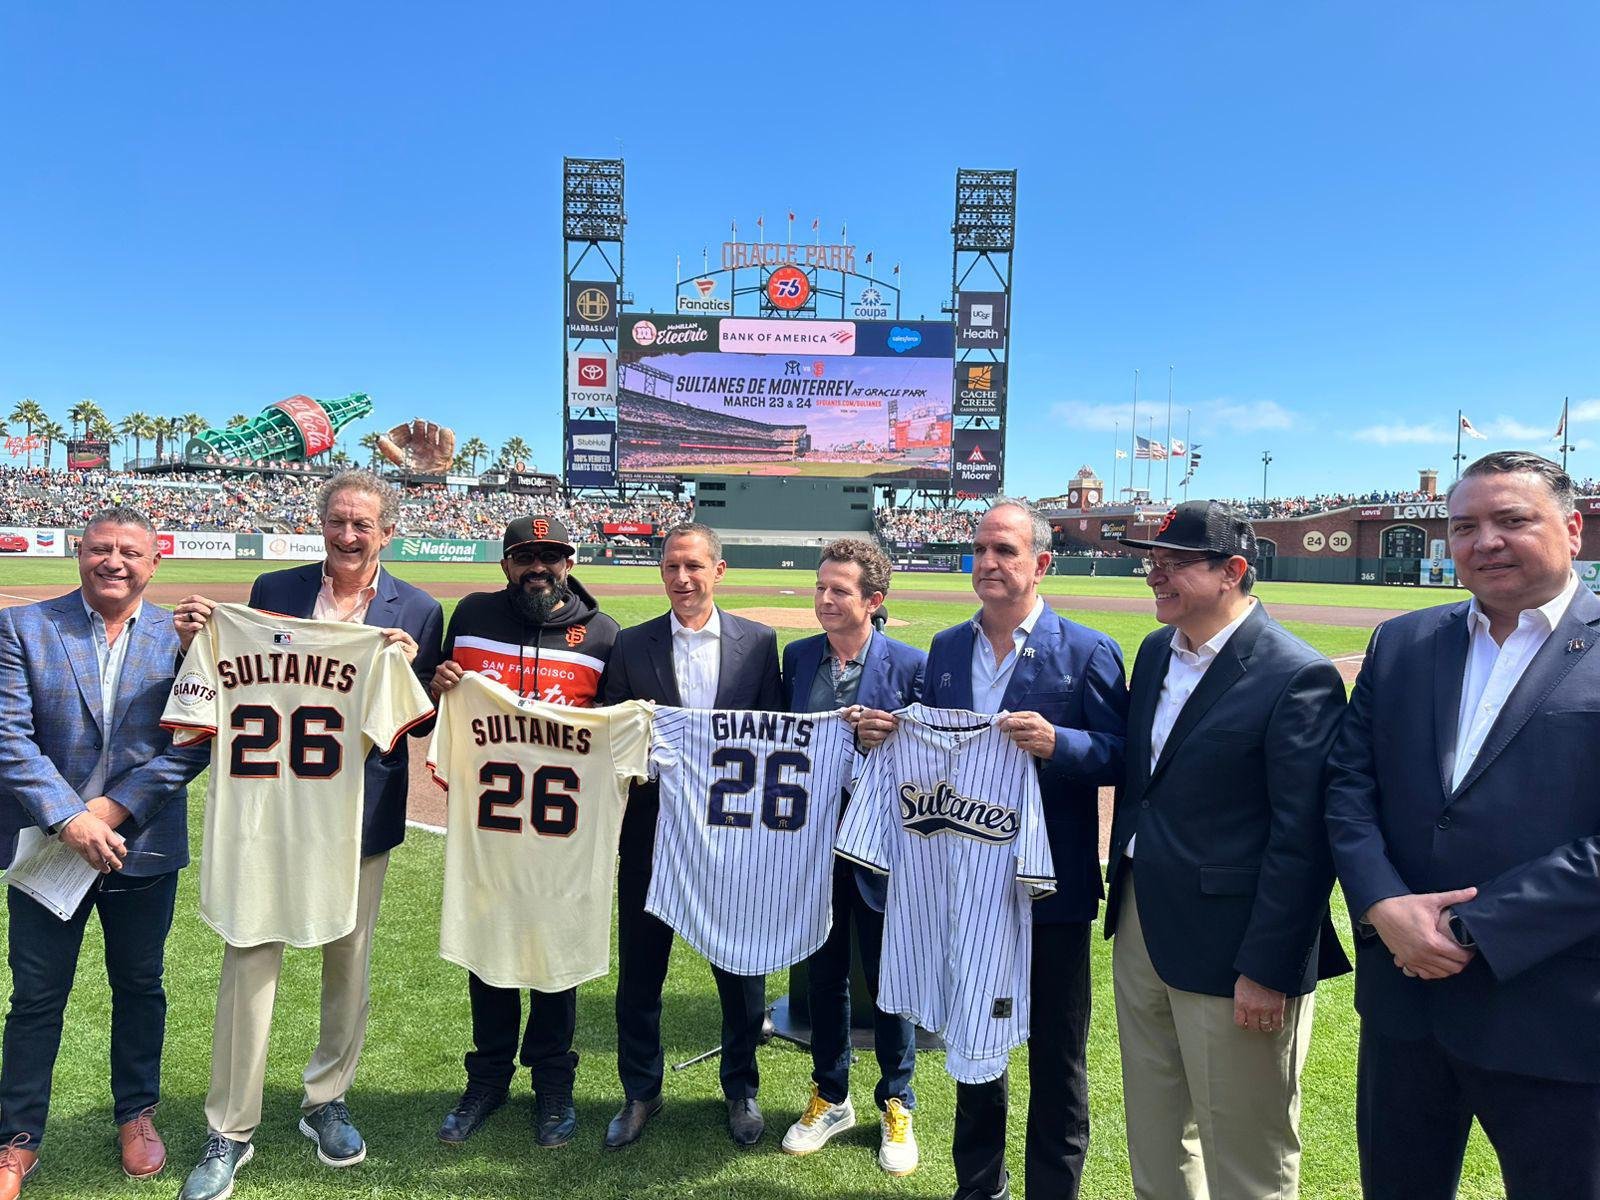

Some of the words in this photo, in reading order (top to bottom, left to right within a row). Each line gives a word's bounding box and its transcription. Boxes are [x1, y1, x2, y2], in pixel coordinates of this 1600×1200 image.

[721, 241, 798, 270] ORACLE
[804, 244, 857, 275] PARK
[777, 278, 801, 297] 76
[679, 297, 730, 311] Fanatics
[854, 306, 888, 318] coupa
[972, 310, 990, 320] UCSF
[570, 324, 599, 332] HABBAS
[600, 325, 616, 333] LAW
[962, 328, 999, 340] Health
[656, 327, 709, 346] Electric
[722, 332, 754, 342] BANK
[757, 333, 773, 343] OF
[774, 334, 828, 344] AMERICA
[892, 335, 919, 344] salesforce
[675, 375, 748, 393] SULTANES
[747, 378, 768, 395] DE
[767, 378, 854, 397] MONTERREY
[851, 388, 866, 396] AT
[864, 388, 901, 397] ORACLE
[902, 388, 928, 398] PARK
[571, 392, 614, 402] TOYOTA
[960, 391, 997, 399] CACHE
[723, 396, 766, 408] MARCH
[768, 397, 784, 408] 23
[786, 400, 793, 408] &
[796, 397, 812, 409] 24
[961, 399, 996, 407] CREEK
[577, 438, 607, 447] StubHub
[956, 462, 997, 473] Benjamin
[961, 471, 990, 480] Moore
[178, 540, 232, 551] TOYOTA
[289, 542, 325, 553] Hanw
[1306, 536, 1323, 547] 24
[1332, 536, 1348, 547] 30
[236, 548, 257, 557] 354
[420, 541, 477, 556] National
[781, 560, 794, 568] 391
[1360, 572, 1376, 581] 365
[217, 653, 357, 694] SULTANES
[482, 659, 505, 671] SAN
[508, 663, 576, 681] FRANCISCO
[173, 682, 217, 702] GIANTS
[471, 714, 593, 755] SULTANES
[711, 711, 815, 748] GIANTS
[230, 704, 345, 780] 26
[707, 746, 812, 832] 26
[477, 761, 581, 838] 26
[900, 781, 1019, 833] Sultanes
